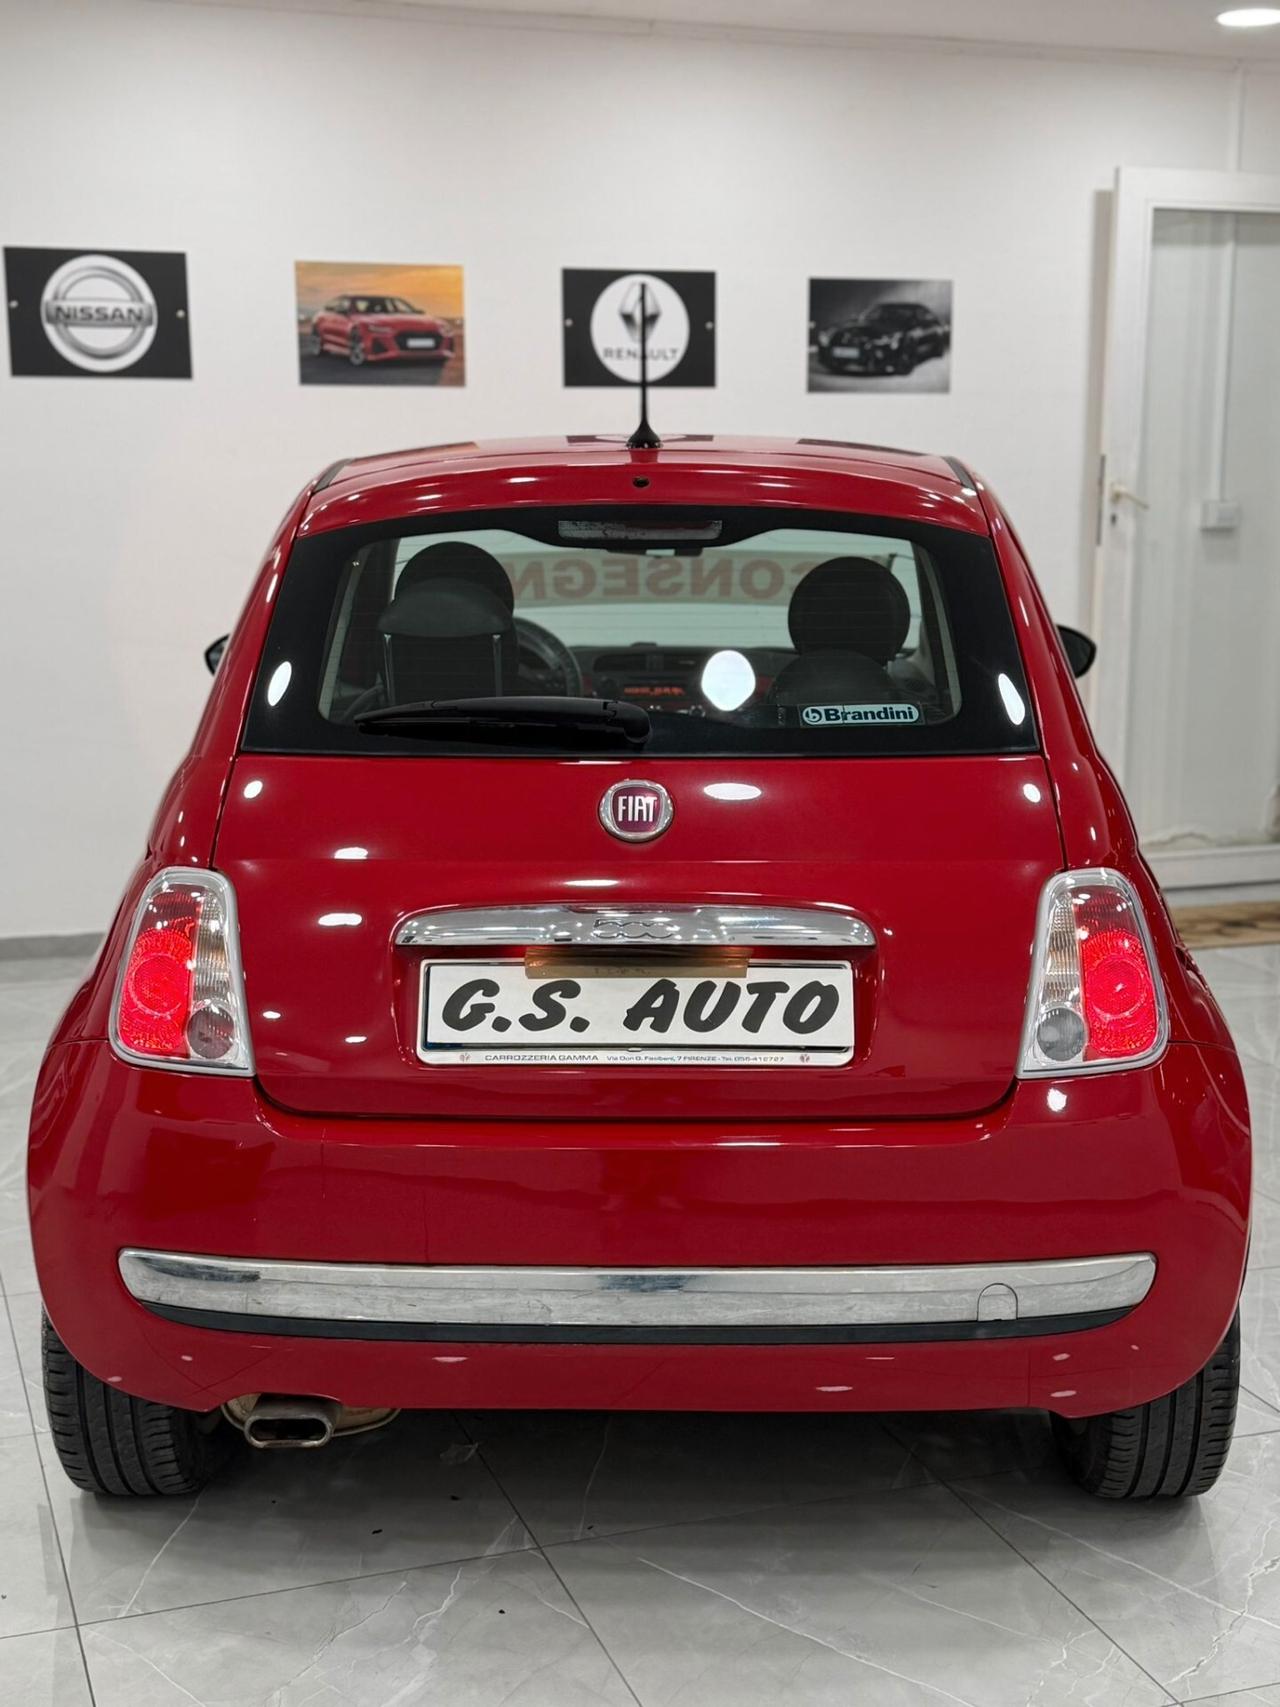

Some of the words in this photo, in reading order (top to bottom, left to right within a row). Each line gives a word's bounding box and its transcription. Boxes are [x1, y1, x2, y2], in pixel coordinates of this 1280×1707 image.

[55, 305, 144, 323] NISSAN
[602, 347, 679, 361] RENULT
[823, 706, 915, 722] Brandini
[617, 795, 658, 823] FIAT
[593, 918, 679, 939] 500
[441, 978, 590, 1034] G.S.
[622, 978, 840, 1035] AUTO
[558, 1054, 599, 1062] GAMMA
